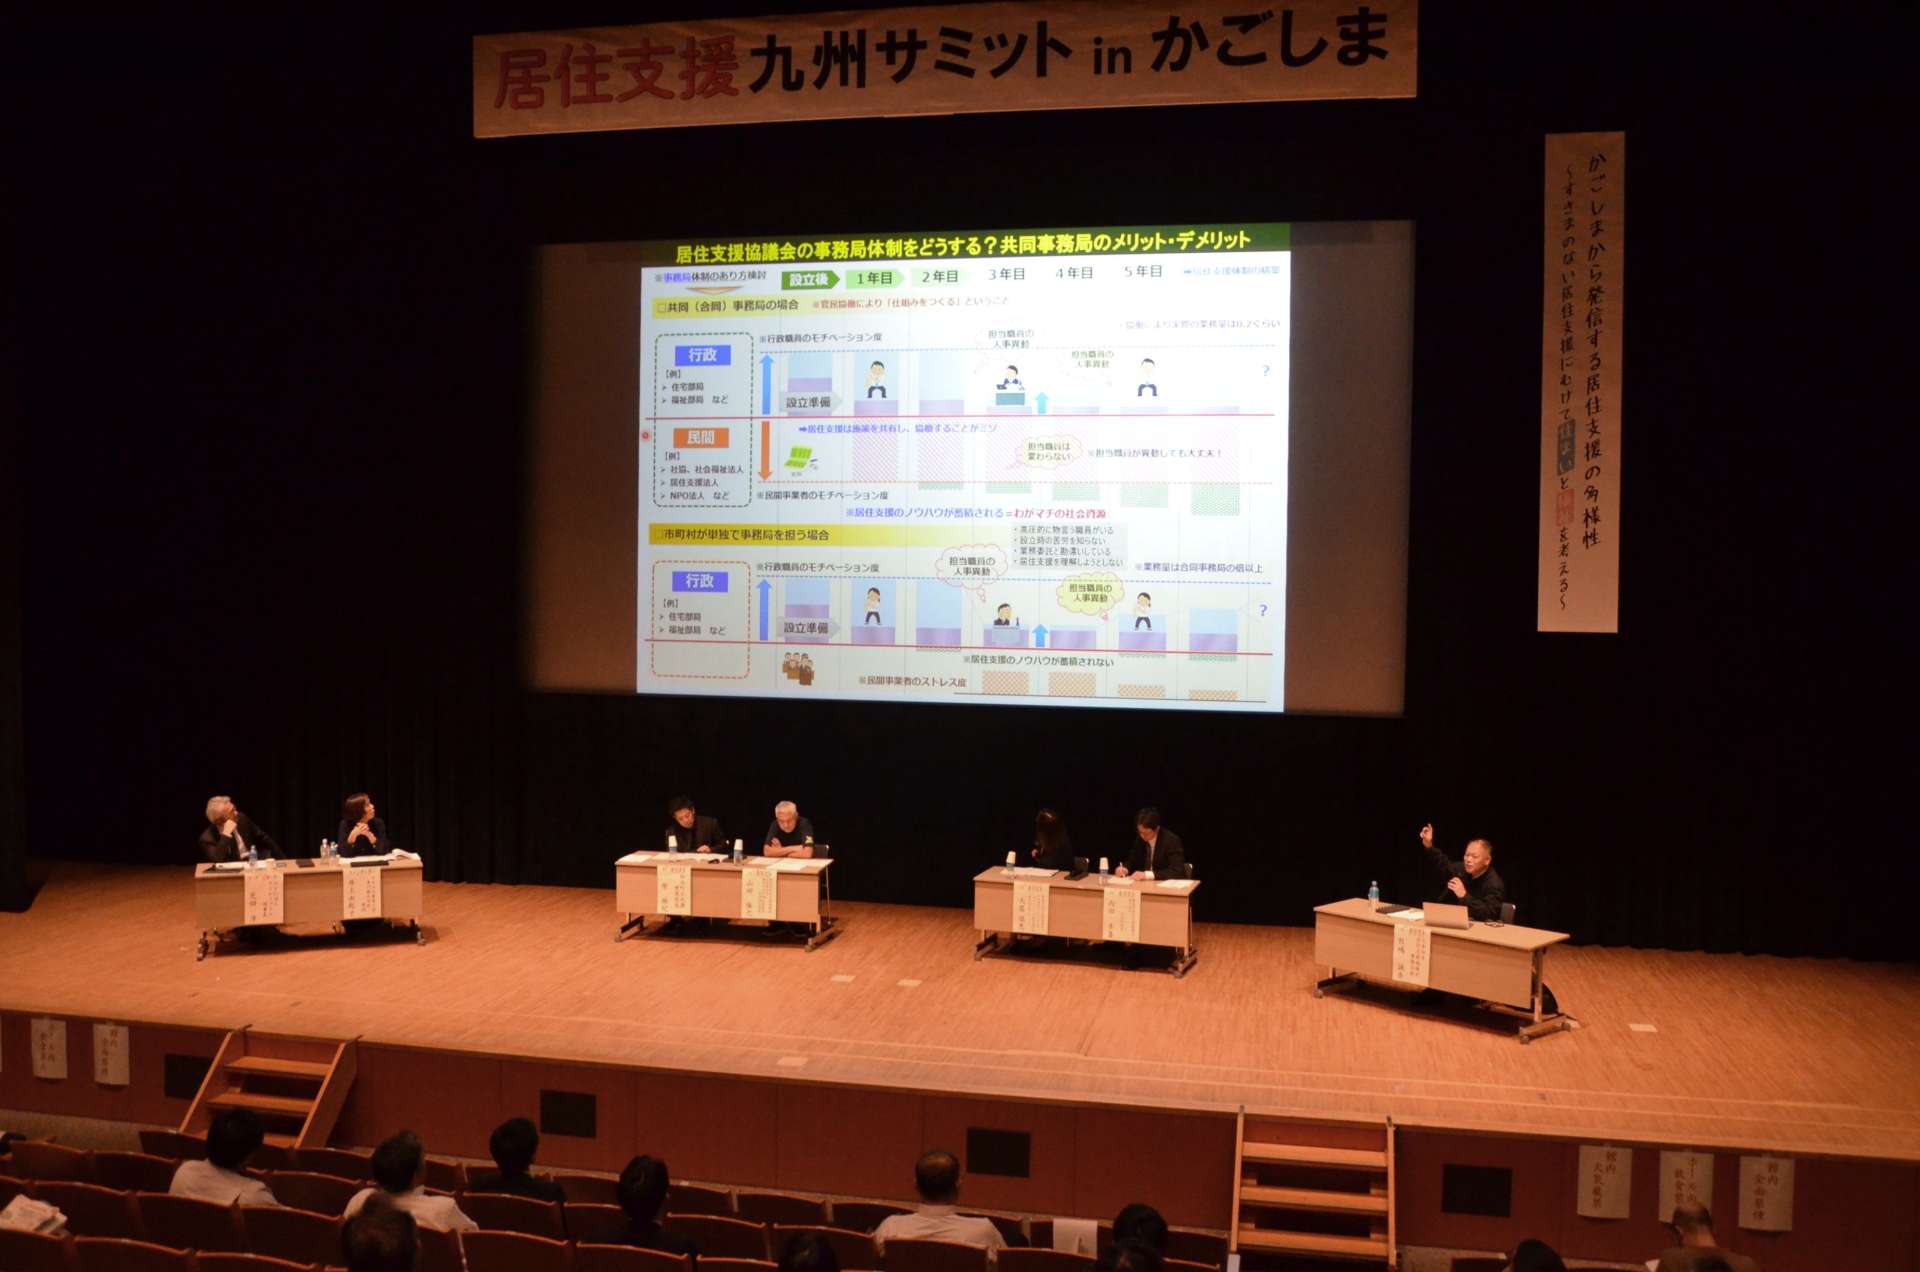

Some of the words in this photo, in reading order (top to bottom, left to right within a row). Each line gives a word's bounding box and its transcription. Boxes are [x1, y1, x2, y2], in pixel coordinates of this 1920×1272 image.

[1094, 37, 1132, 75] in
[1150, 7, 1389, 72] かごしま
[789, 273, 829, 287] 設立後
[688, 347, 717, 362] 行政
[786, 397, 831, 409] 設立準備
[687, 429, 715, 444] 民間
[686, 573, 714, 588] 行政
[784, 622, 829, 634] 設立準備
